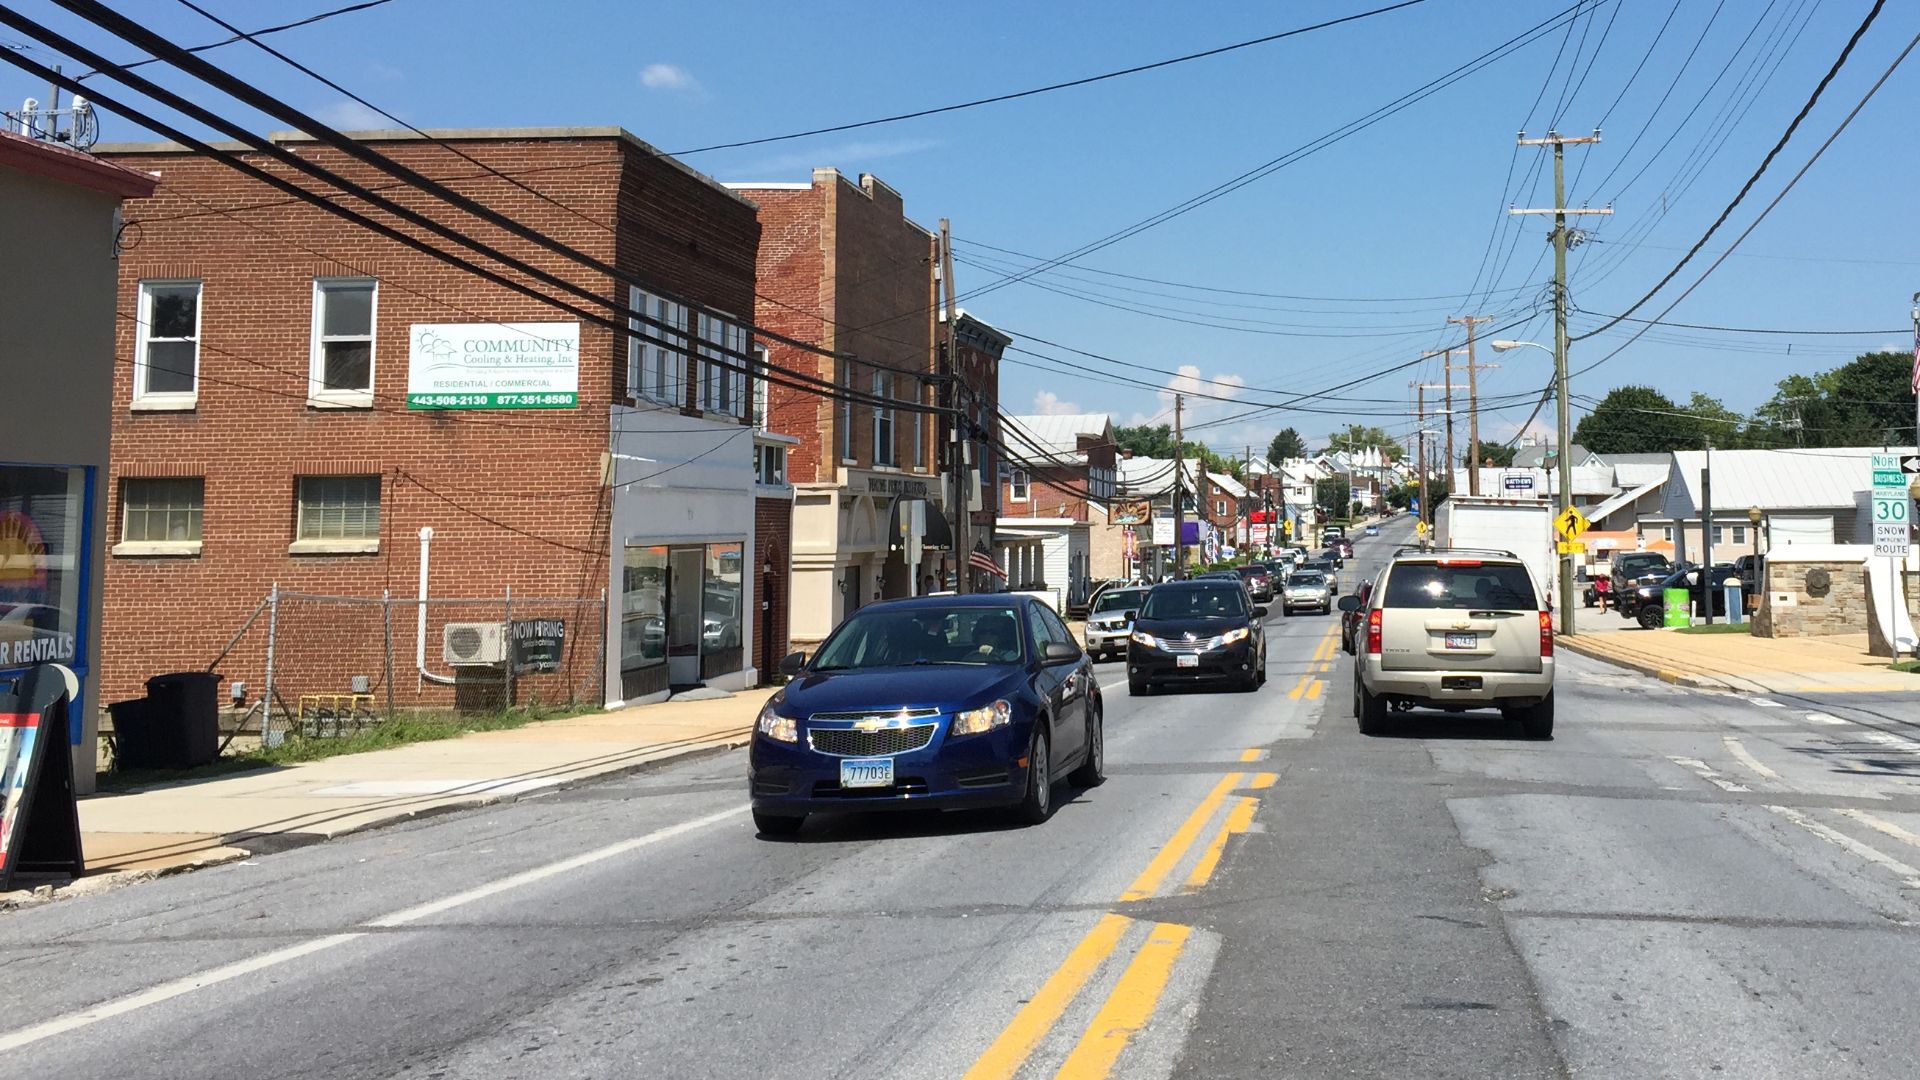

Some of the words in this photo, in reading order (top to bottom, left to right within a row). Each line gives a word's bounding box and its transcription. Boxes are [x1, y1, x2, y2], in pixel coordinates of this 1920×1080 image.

[464, 339, 574, 353] COMMUNITY
[464, 354, 501, 366] Cooling
[505, 355, 513, 363] &
[516, 354, 555, 366] Heating,
[433, 380, 488, 388] RESIDENTIAL
[412, 395, 488, 405] 443-508-2130
[496, 394, 573, 404] 877-351-8580
[1873, 455, 1898, 467] NORT
[1877, 501, 1905, 520] 30
[1877, 526, 1905, 536] SNOW
[1875, 544, 1907, 554] ROUTE
[513, 622, 534, 640] NOW
[535, 621, 564, 637] HIRING
[13, 636, 74, 663] RENTALS
